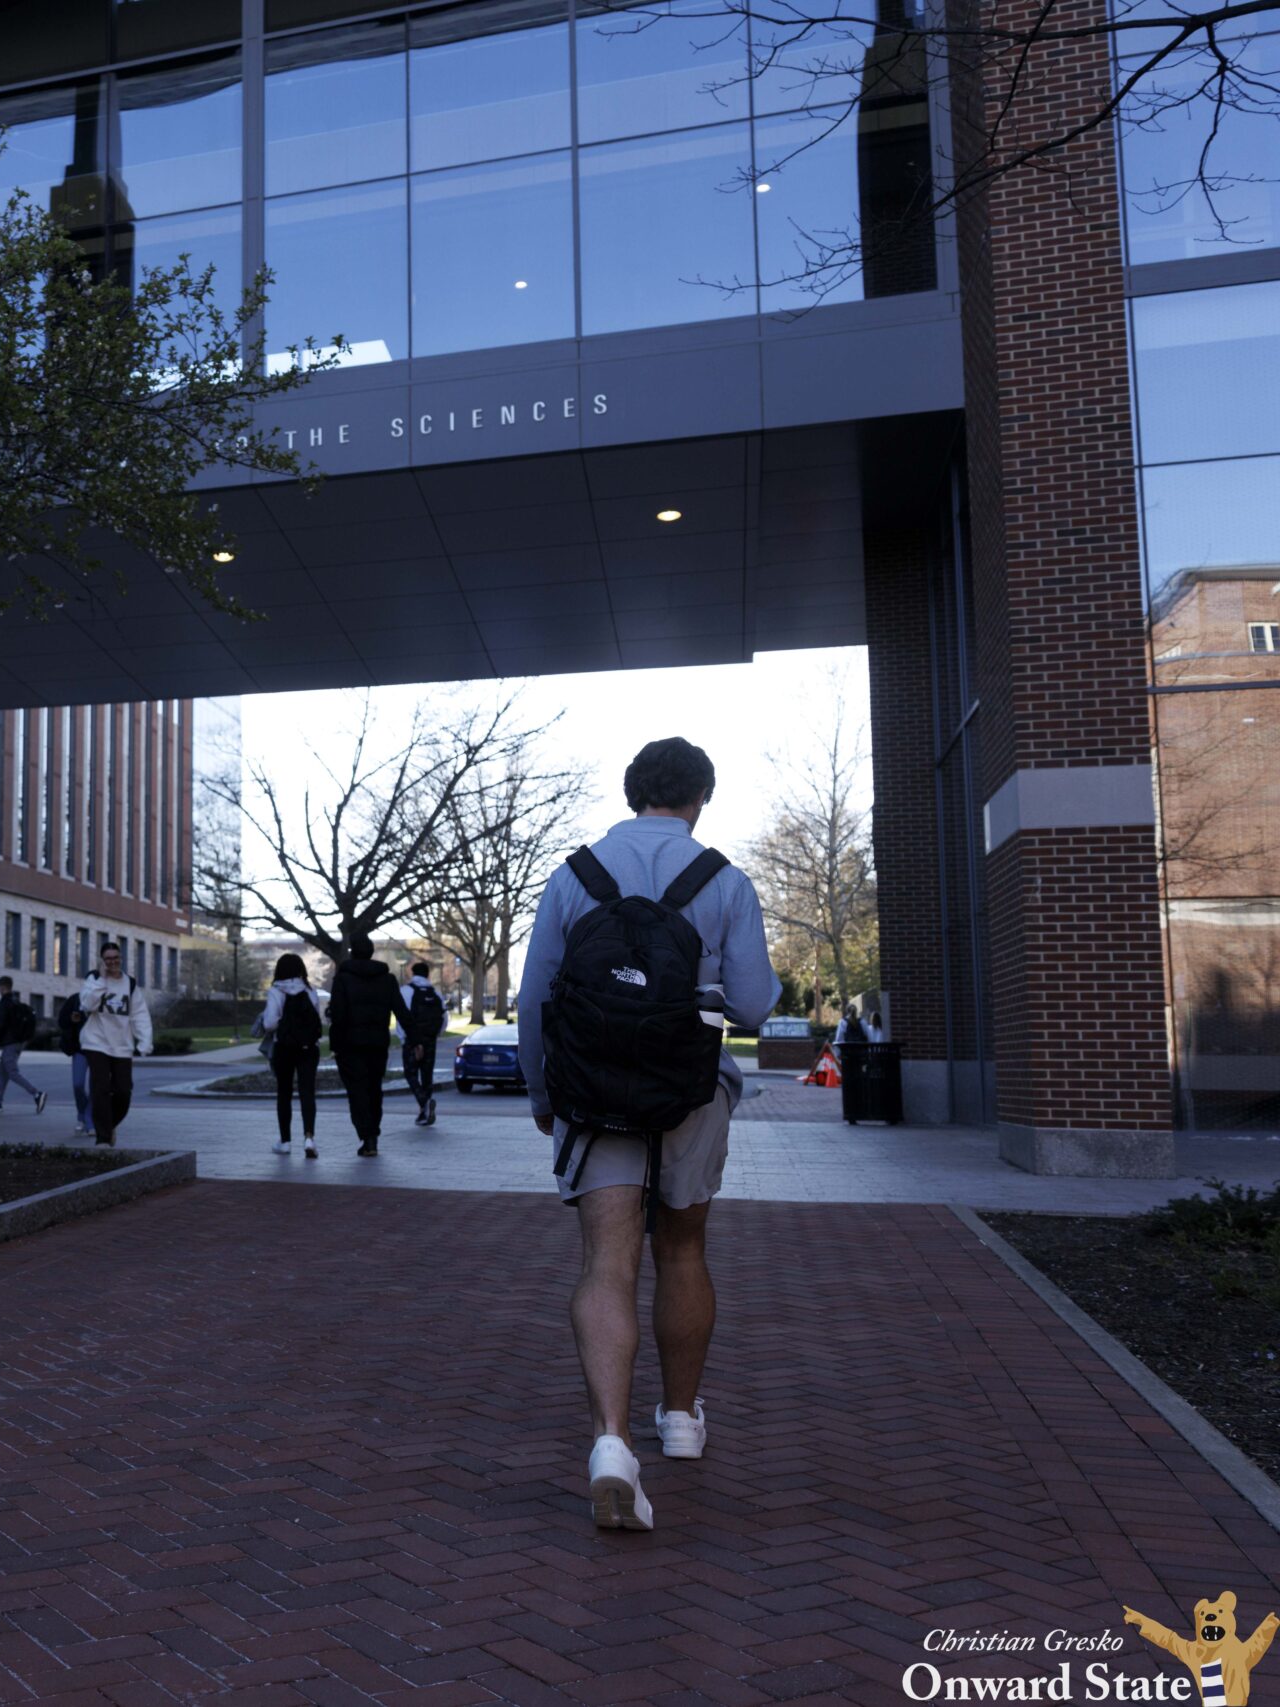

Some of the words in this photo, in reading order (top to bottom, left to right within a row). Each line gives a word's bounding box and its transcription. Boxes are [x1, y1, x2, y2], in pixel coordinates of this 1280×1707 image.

[284, 424, 350, 449] THE
[391, 394, 608, 437] SCIENCES
[623, 966, 637, 975] THE
